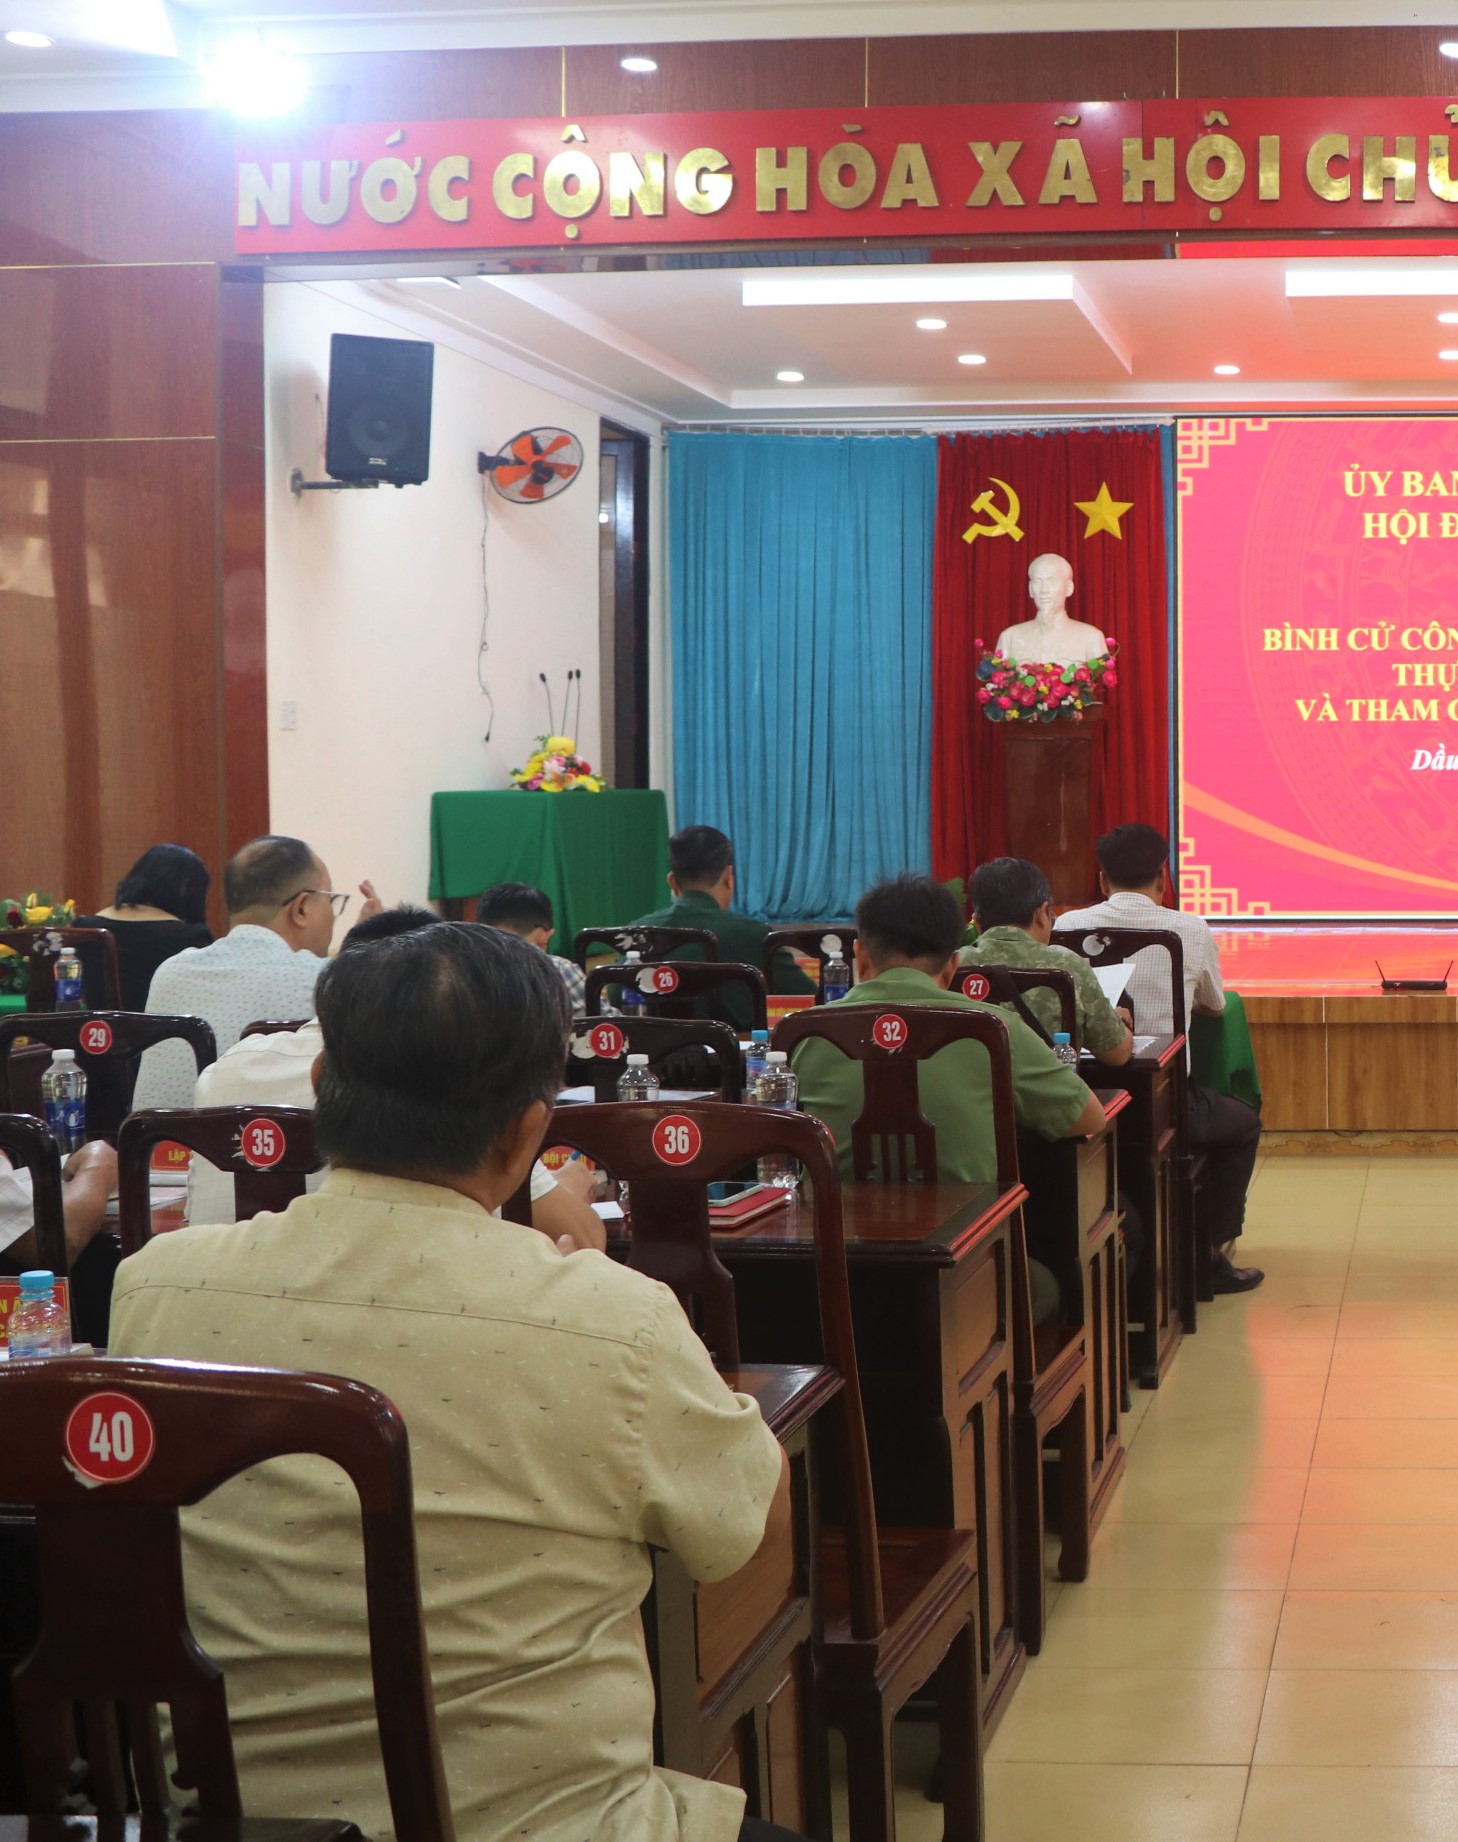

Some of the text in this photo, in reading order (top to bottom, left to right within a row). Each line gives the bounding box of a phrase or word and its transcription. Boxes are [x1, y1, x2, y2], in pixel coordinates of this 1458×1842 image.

[238, 130, 469, 227] NƯỚC
[492, 125, 734, 238] CỘNG
[755, 124, 939, 211] HÒA
[966, 115, 1098, 207] XÃ
[1122, 110, 1280, 221] HỘI
[1343, 463, 1393, 497] ỦY
[1363, 508, 1430, 545] HỘI
[1263, 621, 1339, 651] BÌNH
[1347, 621, 1396, 651] CỬ
[1295, 692, 1339, 722] VÀ
[1345, 698, 1439, 722] THAM
[658, 971, 673, 988] 26
[969, 980, 984, 996] 27
[88, 1027, 107, 1048] 29
[598, 1030, 615, 1051] 31
[882, 1020, 902, 1042] 32
[251, 1128, 275, 1156] 35
[664, 1125, 690, 1155] 36
[88, 1411, 134, 1462] 40
